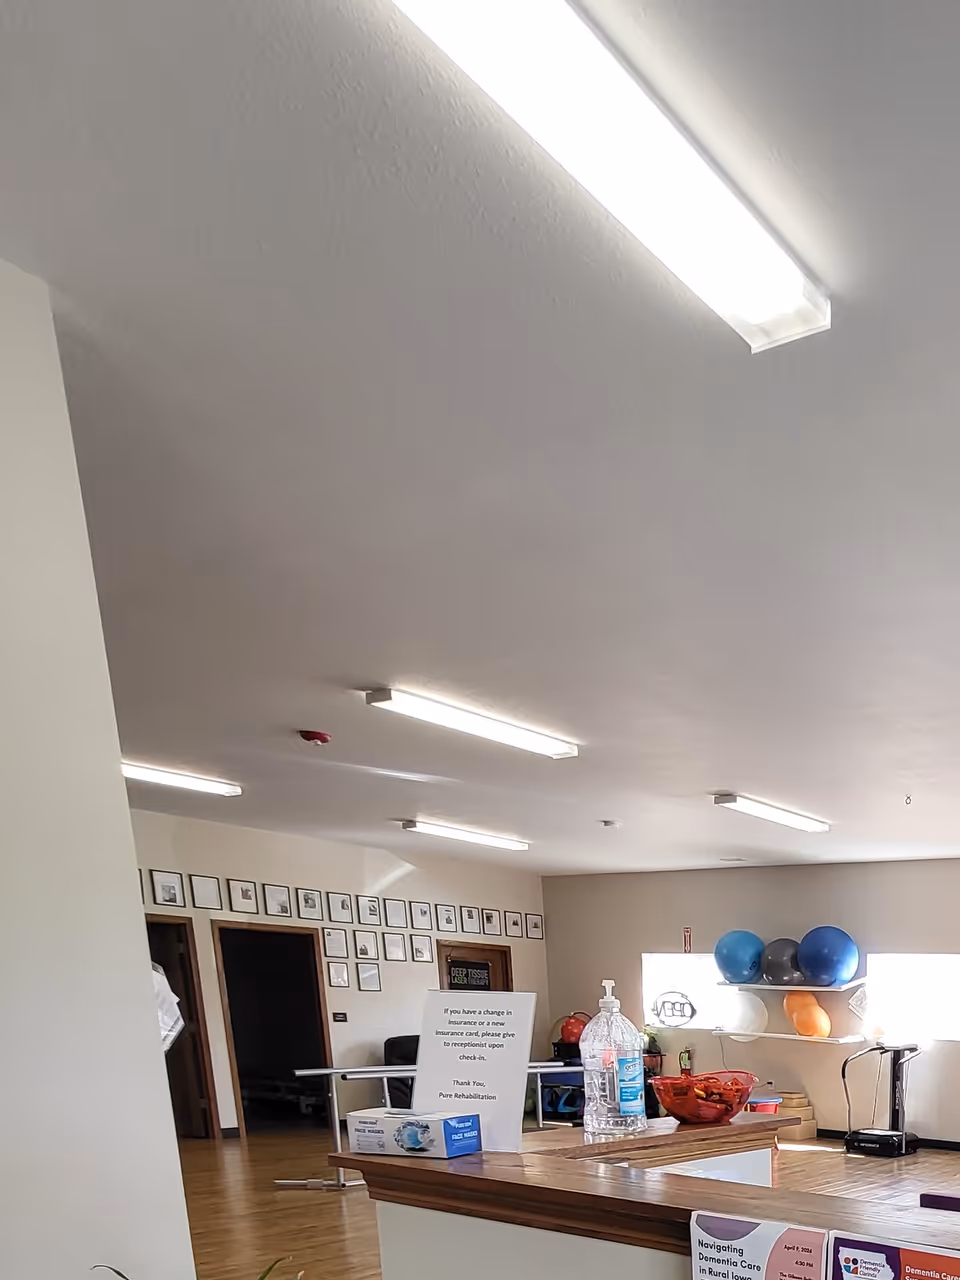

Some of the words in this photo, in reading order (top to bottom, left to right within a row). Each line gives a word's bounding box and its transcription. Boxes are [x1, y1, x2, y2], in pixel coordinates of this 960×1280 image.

[451, 968, 466, 976] DEEP
[468, 969, 488, 979] TISSUE
[698, 1239, 744, 1257] Navigating
[698, 1253, 738, 1267] Dementia
[741, 1260, 761, 1272] Care
[859, 1258, 885, 1268] Dementia
[860, 1264, 881, 1273] Friendly
[699, 1266, 707, 1275] in
[709, 1267, 729, 1280] Rural
[859, 1270, 877, 1278] Clarinda
[905, 1265, 940, 1279] Dementia
